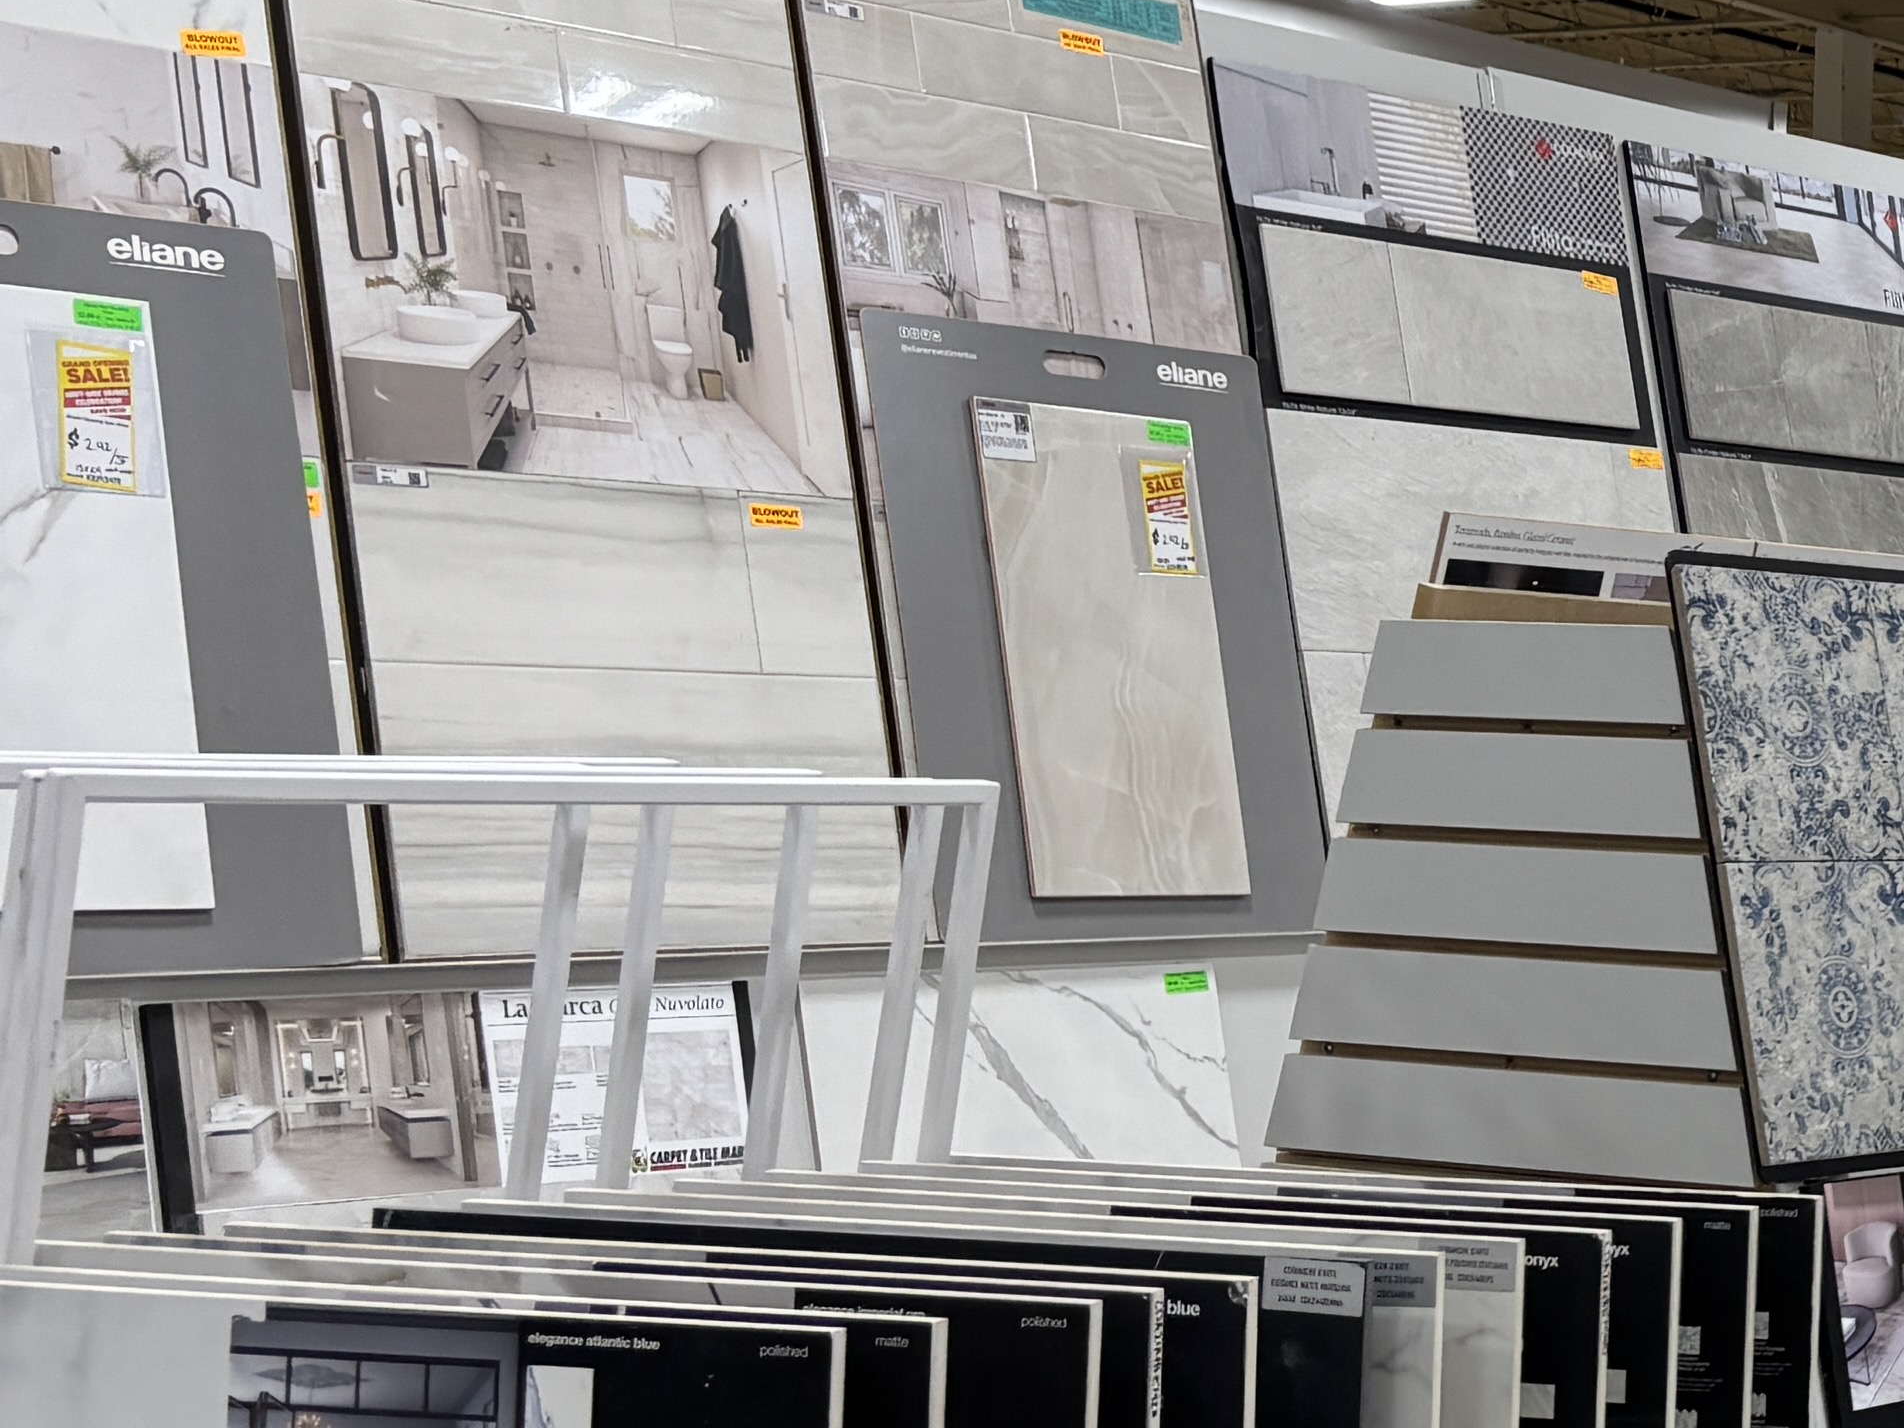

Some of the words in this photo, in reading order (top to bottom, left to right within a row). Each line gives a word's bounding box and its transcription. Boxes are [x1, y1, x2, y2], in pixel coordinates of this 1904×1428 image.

[186, 34, 238, 44] BLOWOUT
[107, 234, 225, 271] eliane
[66, 367, 131, 385] SALE!
[1156, 360, 1229, 389] eliane
[67, 428, 80, 450] $
[751, 506, 799, 518] BLOWOUT
[502, 999, 529, 1019] La
[650, 1149, 688, 1164] CARPET
[690, 1148, 698, 1162] &
[720, 1145, 744, 1160] MAR
[1525, 1254, 1559, 1269] onyx
[1166, 1299, 1201, 1316] blue
[1020, 1315, 1067, 1330] polished
[527, 1332, 583, 1348] elegance
[585, 1334, 631, 1349] atlantic
[633, 1335, 660, 1351] blue
[875, 1335, 910, 1348] matte
[759, 1344, 809, 1358] polished
